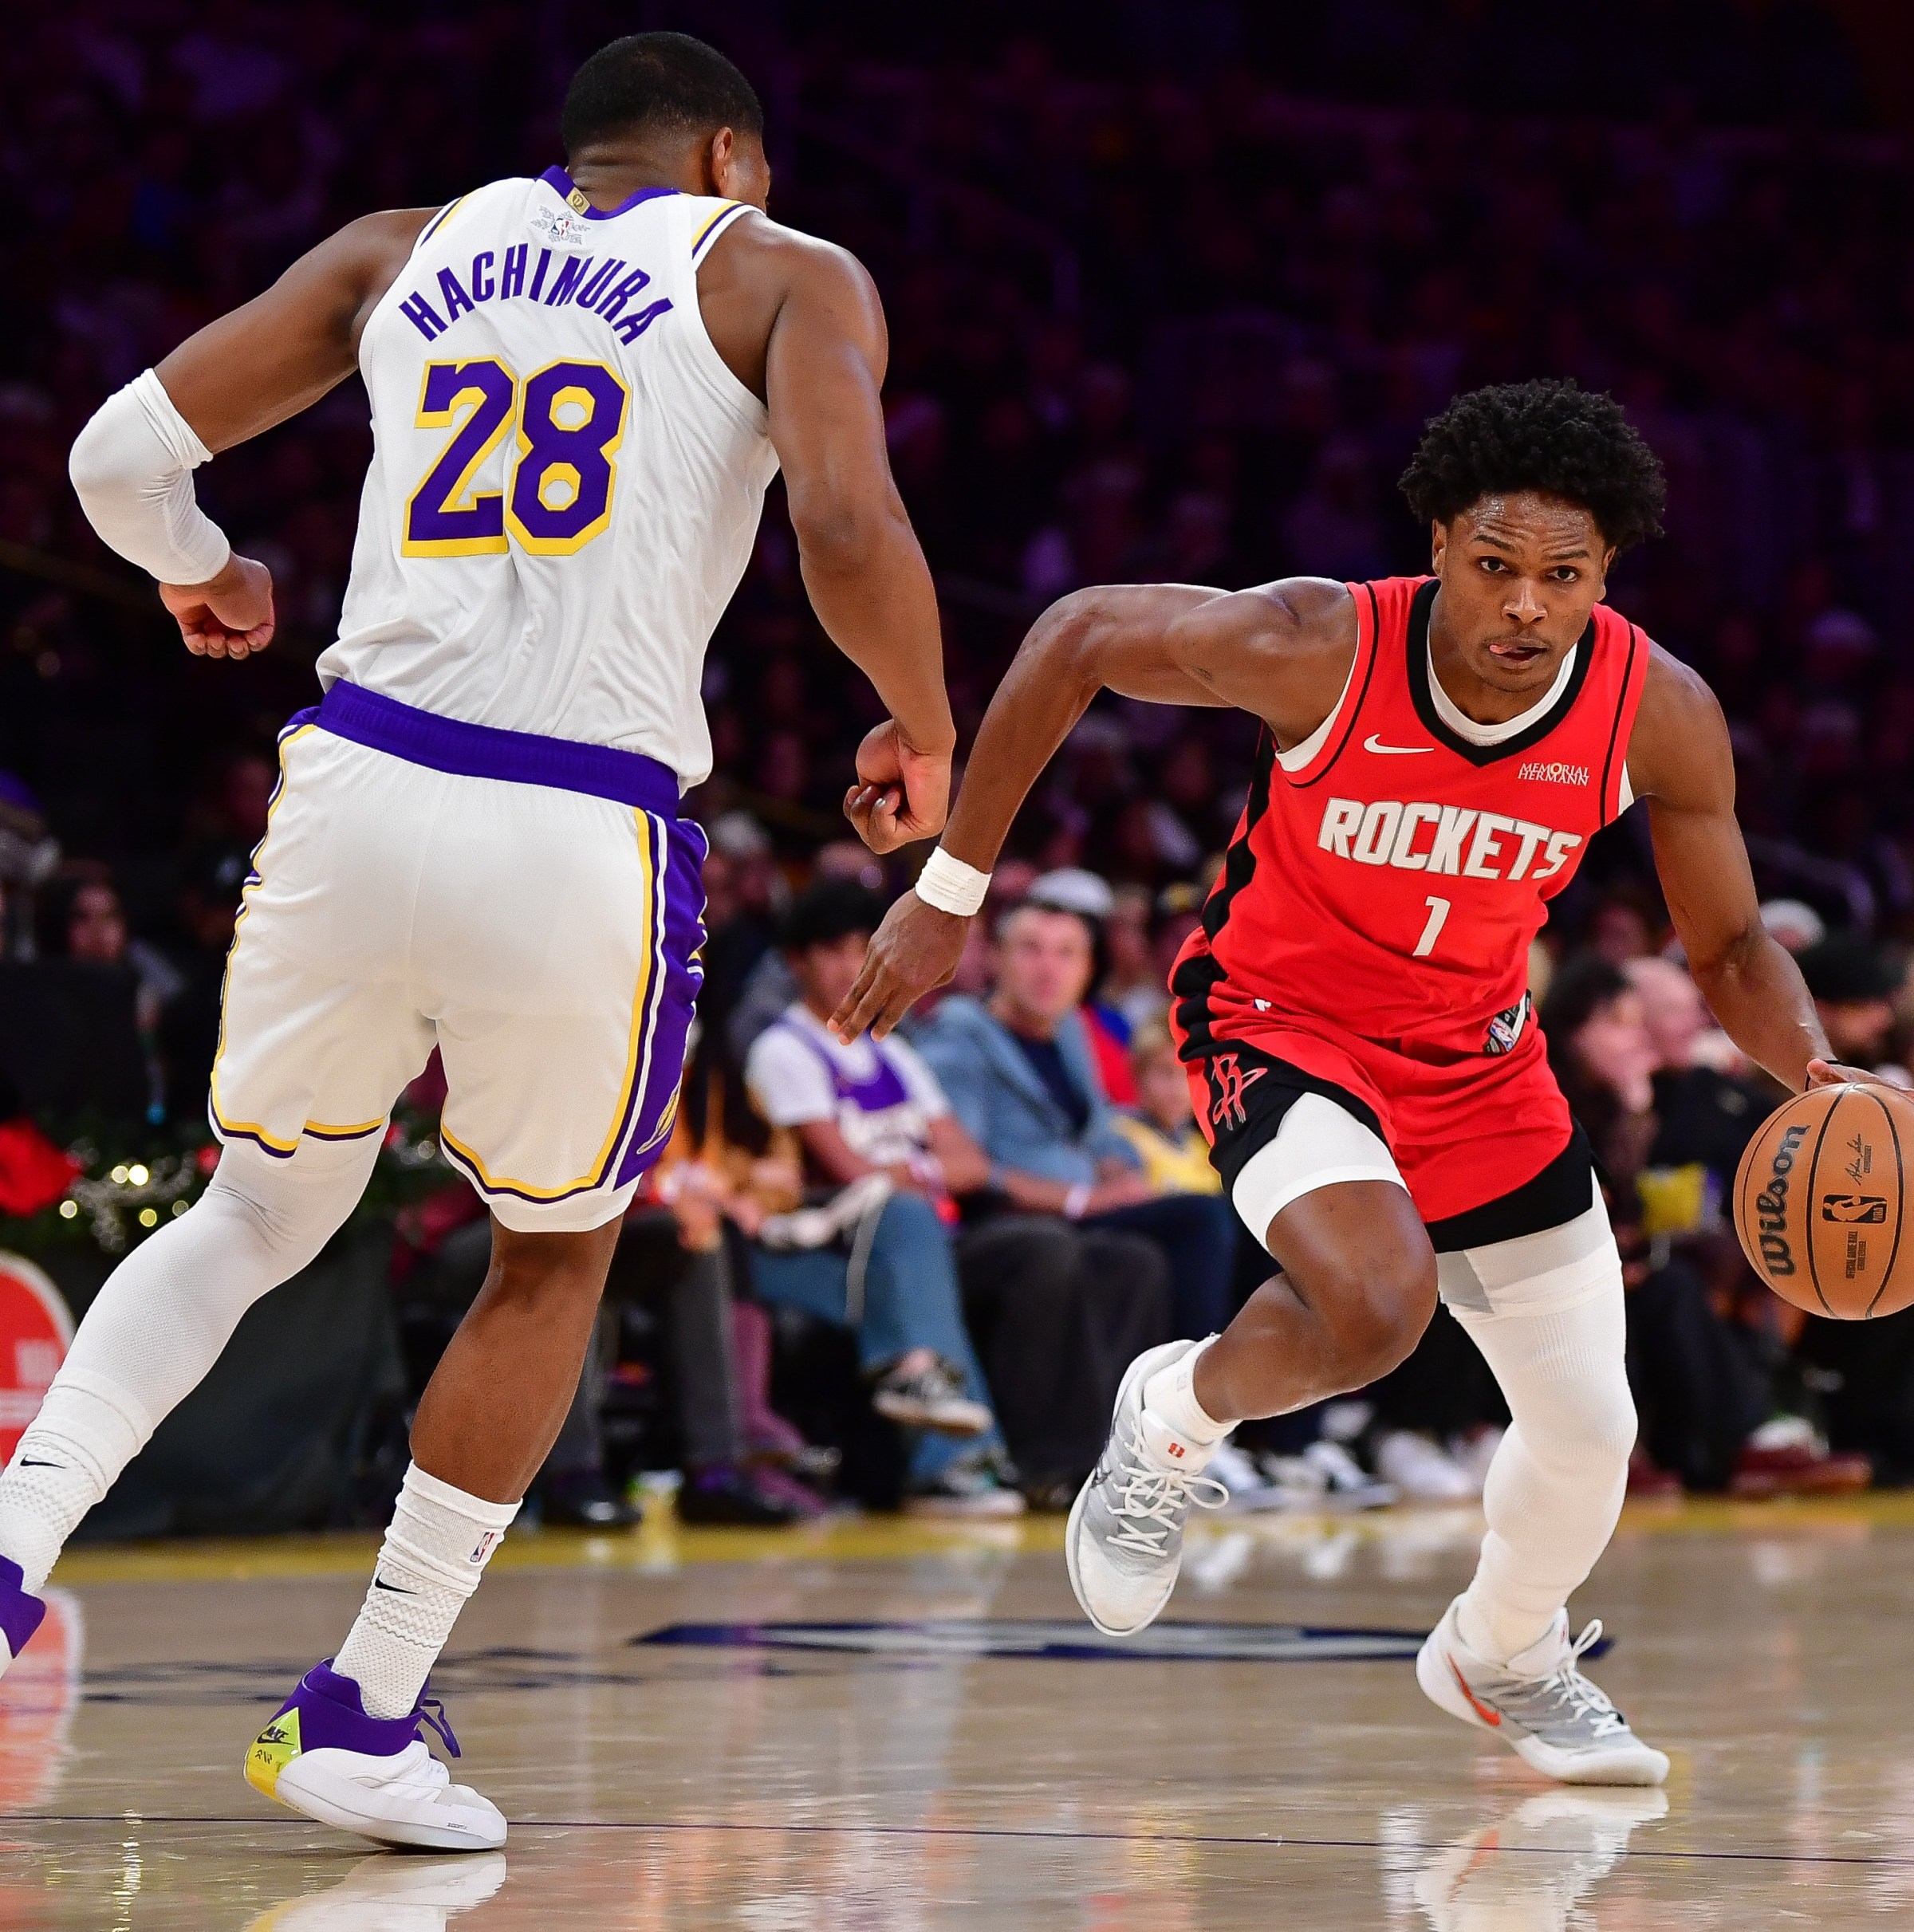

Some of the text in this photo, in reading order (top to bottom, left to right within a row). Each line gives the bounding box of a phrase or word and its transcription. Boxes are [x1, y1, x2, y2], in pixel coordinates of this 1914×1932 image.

[399, 243, 674, 346] HACHIMURA
[400, 355, 632, 557] 28
[1518, 769, 1589, 786] HERMANN
[1519, 762, 1590, 779] MEMORIAL
[1317, 797, 1583, 881] ROCKETS
[1412, 896, 1451, 957] 1
[1756, 1125, 1811, 1276] Wilson
[1873, 1206, 1884, 1222] NBA
